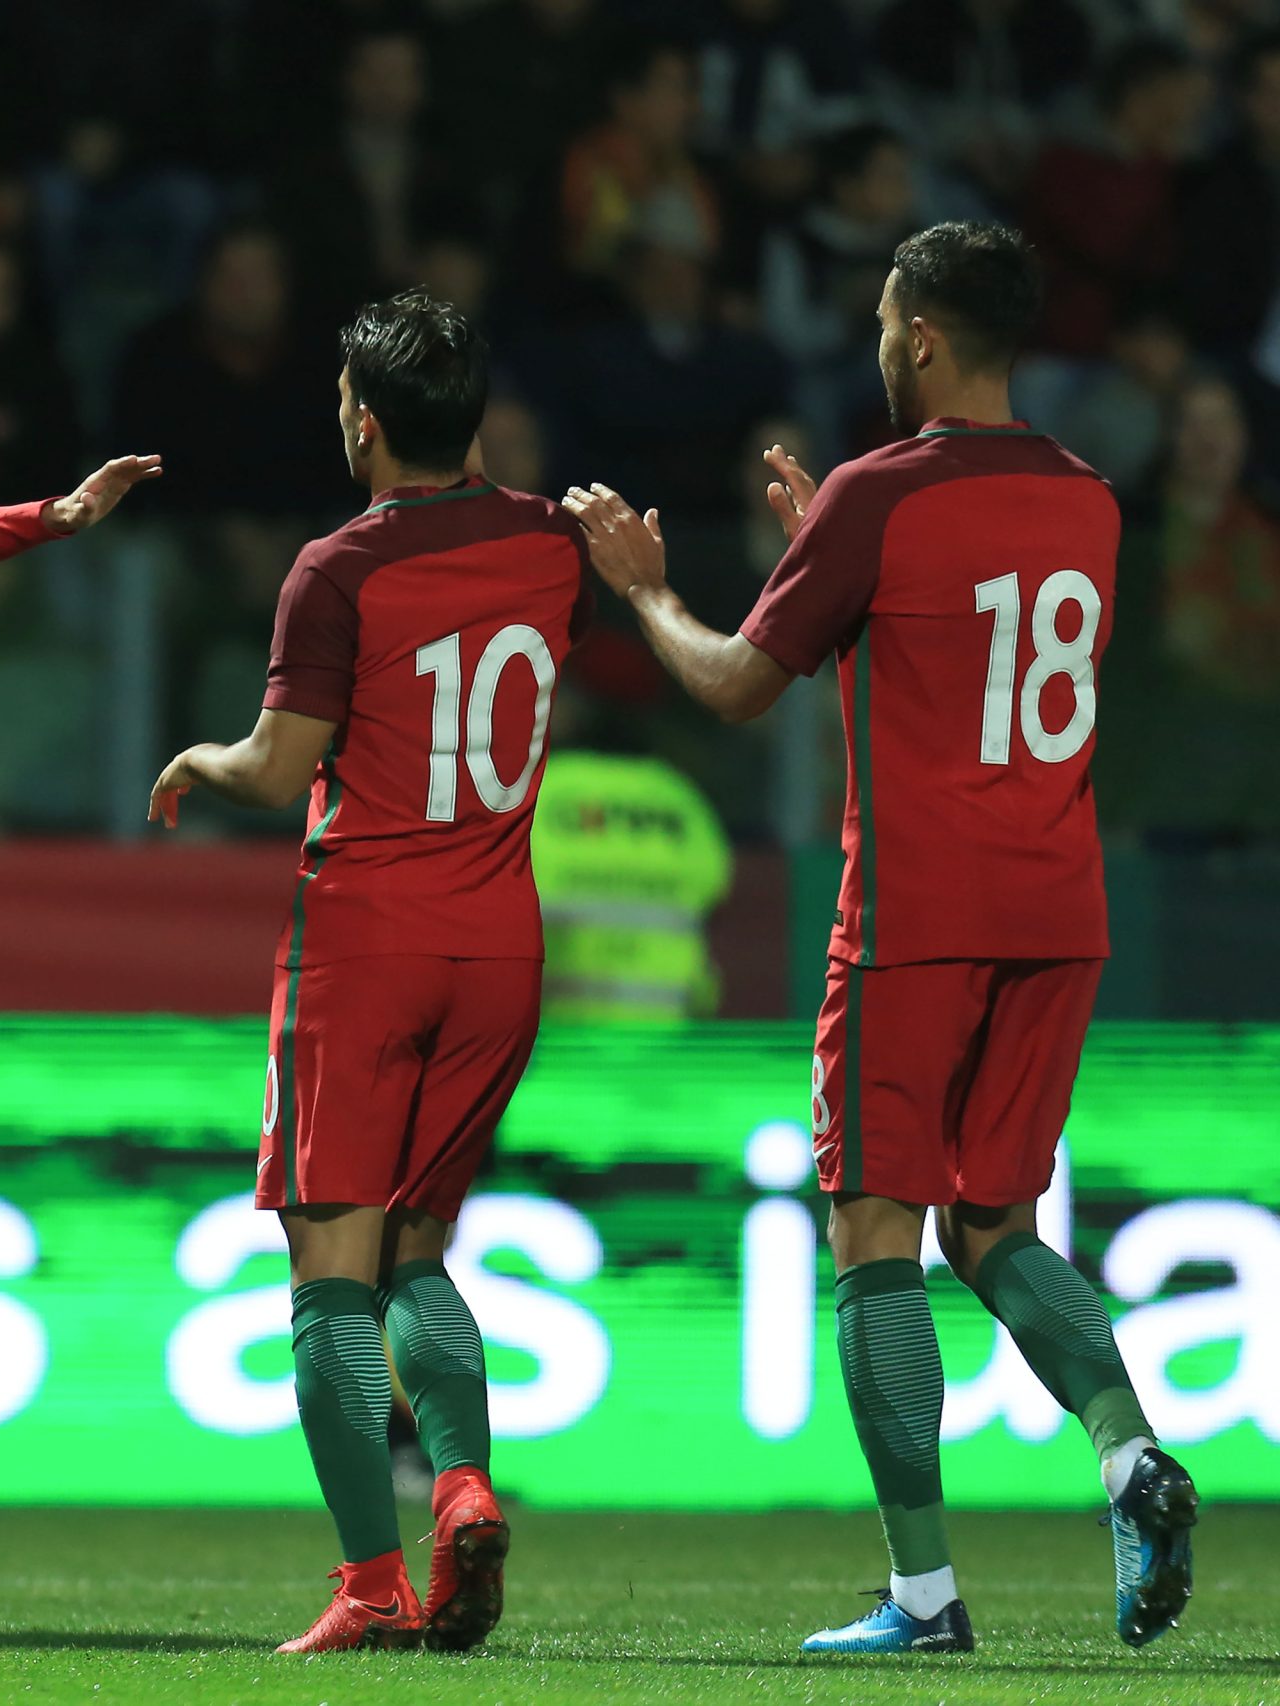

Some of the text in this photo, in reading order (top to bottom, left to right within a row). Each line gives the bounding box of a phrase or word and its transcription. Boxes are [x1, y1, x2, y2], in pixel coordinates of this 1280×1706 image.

[415, 623, 557, 823] 10
[974, 569, 1102, 765] 18
[262, 1054, 279, 1136] 0
[165, 1190, 614, 1442] as
